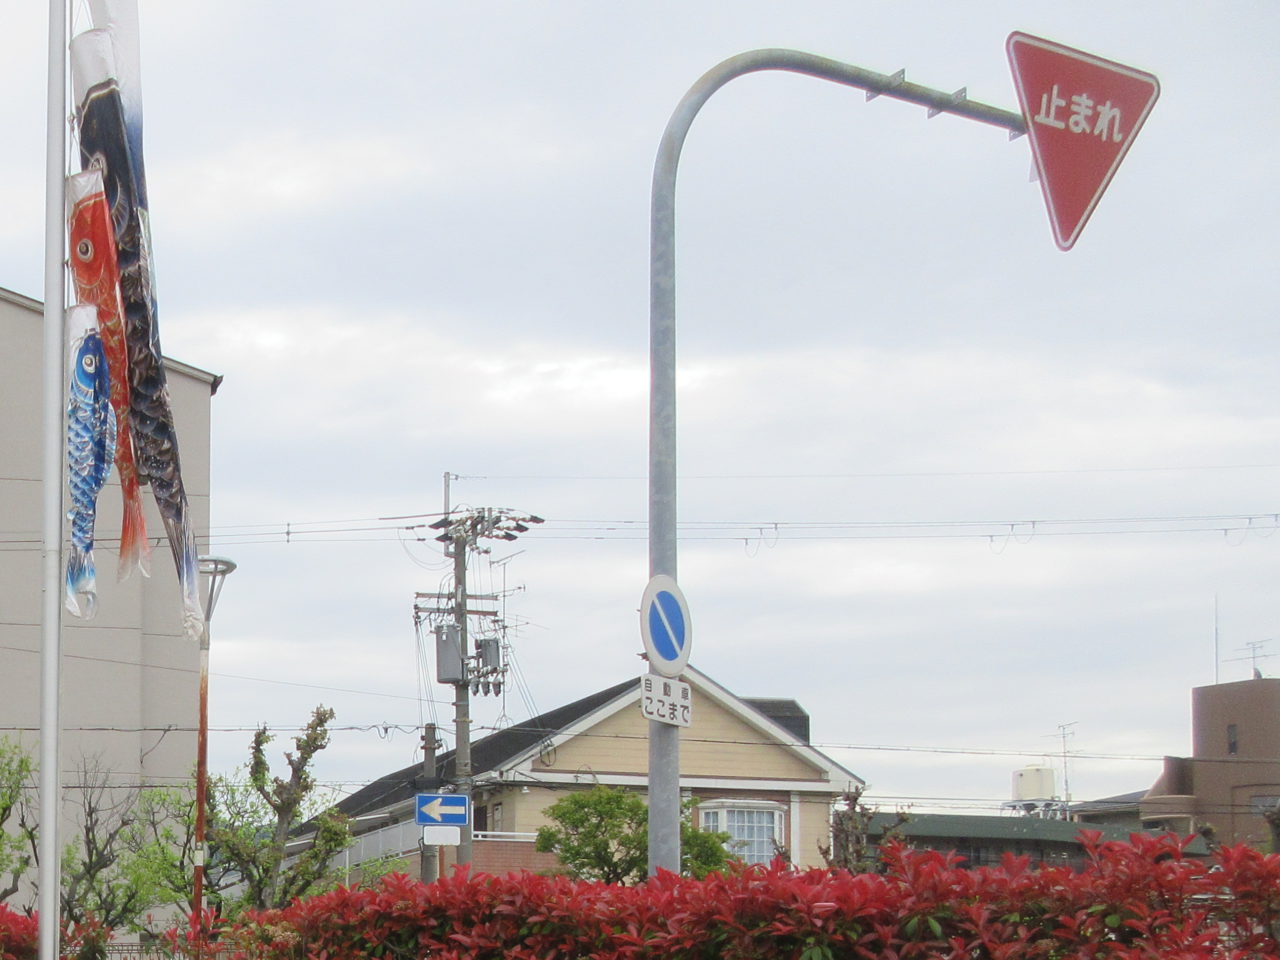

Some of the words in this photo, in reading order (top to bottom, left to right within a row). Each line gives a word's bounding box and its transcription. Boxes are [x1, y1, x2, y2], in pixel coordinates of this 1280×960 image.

[1034, 84, 1122, 143] 止まれ
[644, 696, 690, 723] ここまで
